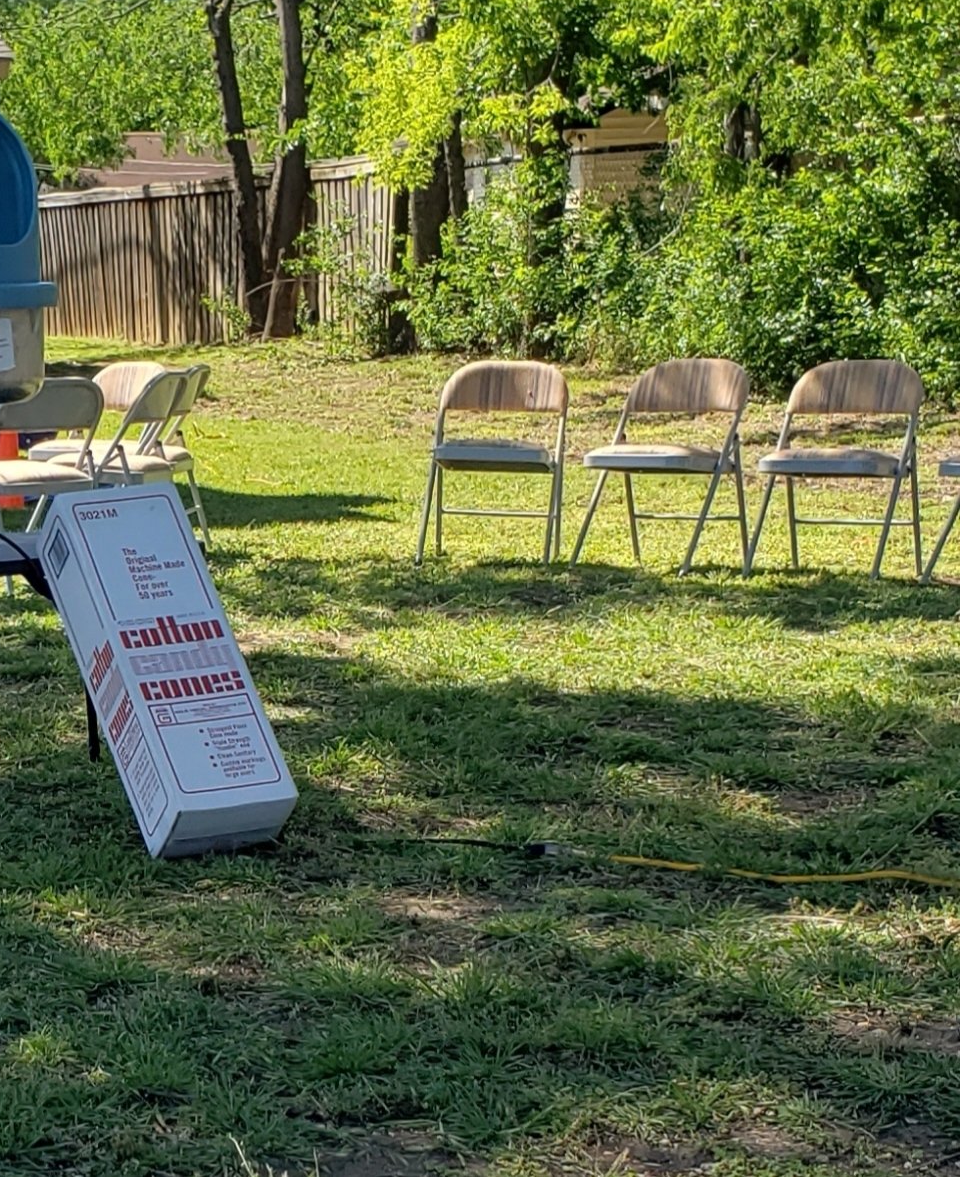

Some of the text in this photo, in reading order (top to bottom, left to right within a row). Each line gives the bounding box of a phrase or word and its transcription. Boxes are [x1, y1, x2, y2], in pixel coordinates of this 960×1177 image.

[79, 508, 118, 521] 3021M
[122, 547, 137, 556] The
[125, 554, 157, 565] Original
[128, 560, 186, 574] Machine Made
[135, 581, 169, 592] For over
[138, 589, 174, 600] 50 years
[119, 615, 225, 650] cotton
[128, 642, 238, 676] candy
[89, 639, 115, 696] cotton
[139, 670, 246, 701] cones
[108, 689, 135, 746] cones
